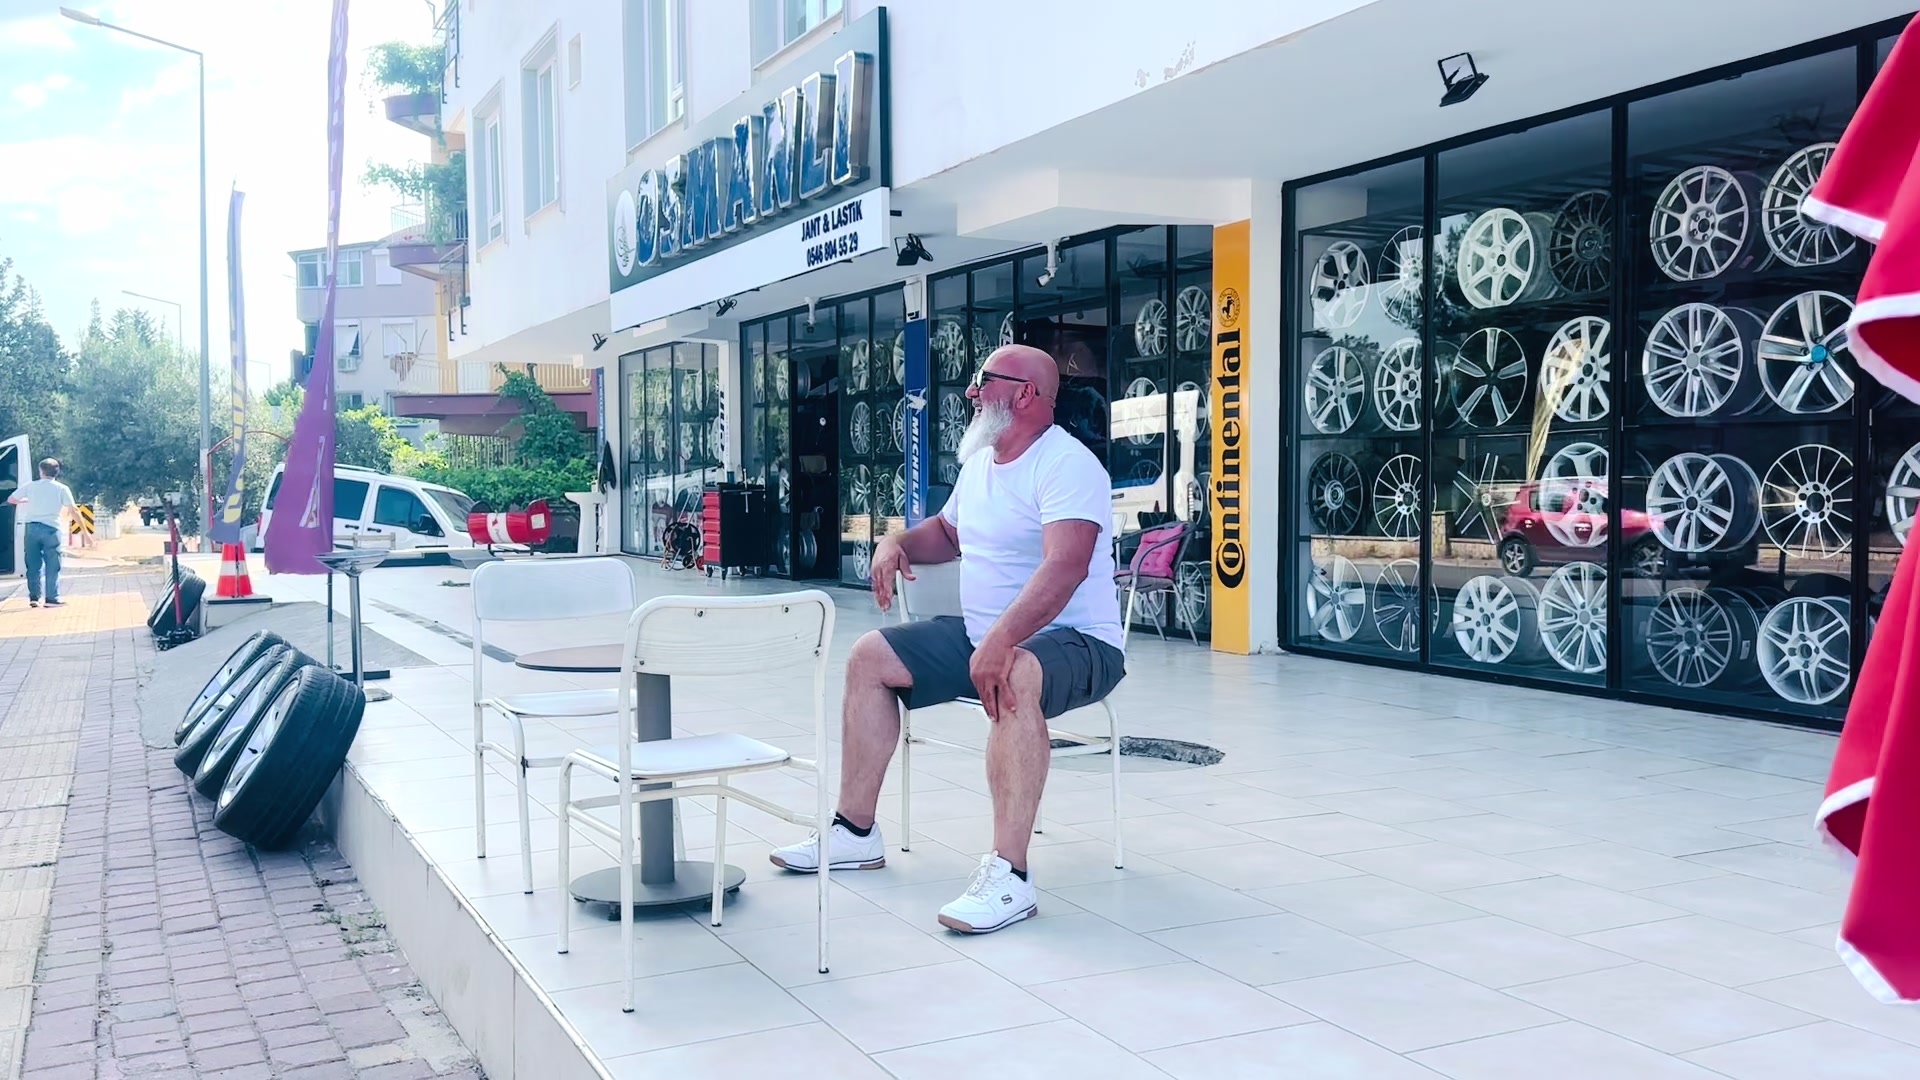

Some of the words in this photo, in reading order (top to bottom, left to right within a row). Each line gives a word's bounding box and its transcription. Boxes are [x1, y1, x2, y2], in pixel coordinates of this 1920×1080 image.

[636, 50, 870, 267] OSMANLI
[801, 215, 821, 242] JANT
[823, 213, 830, 233] &
[807, 244, 823, 267] 0546
[911, 416, 920, 515] MICHELIN
[1216, 327, 1245, 588] Continental
